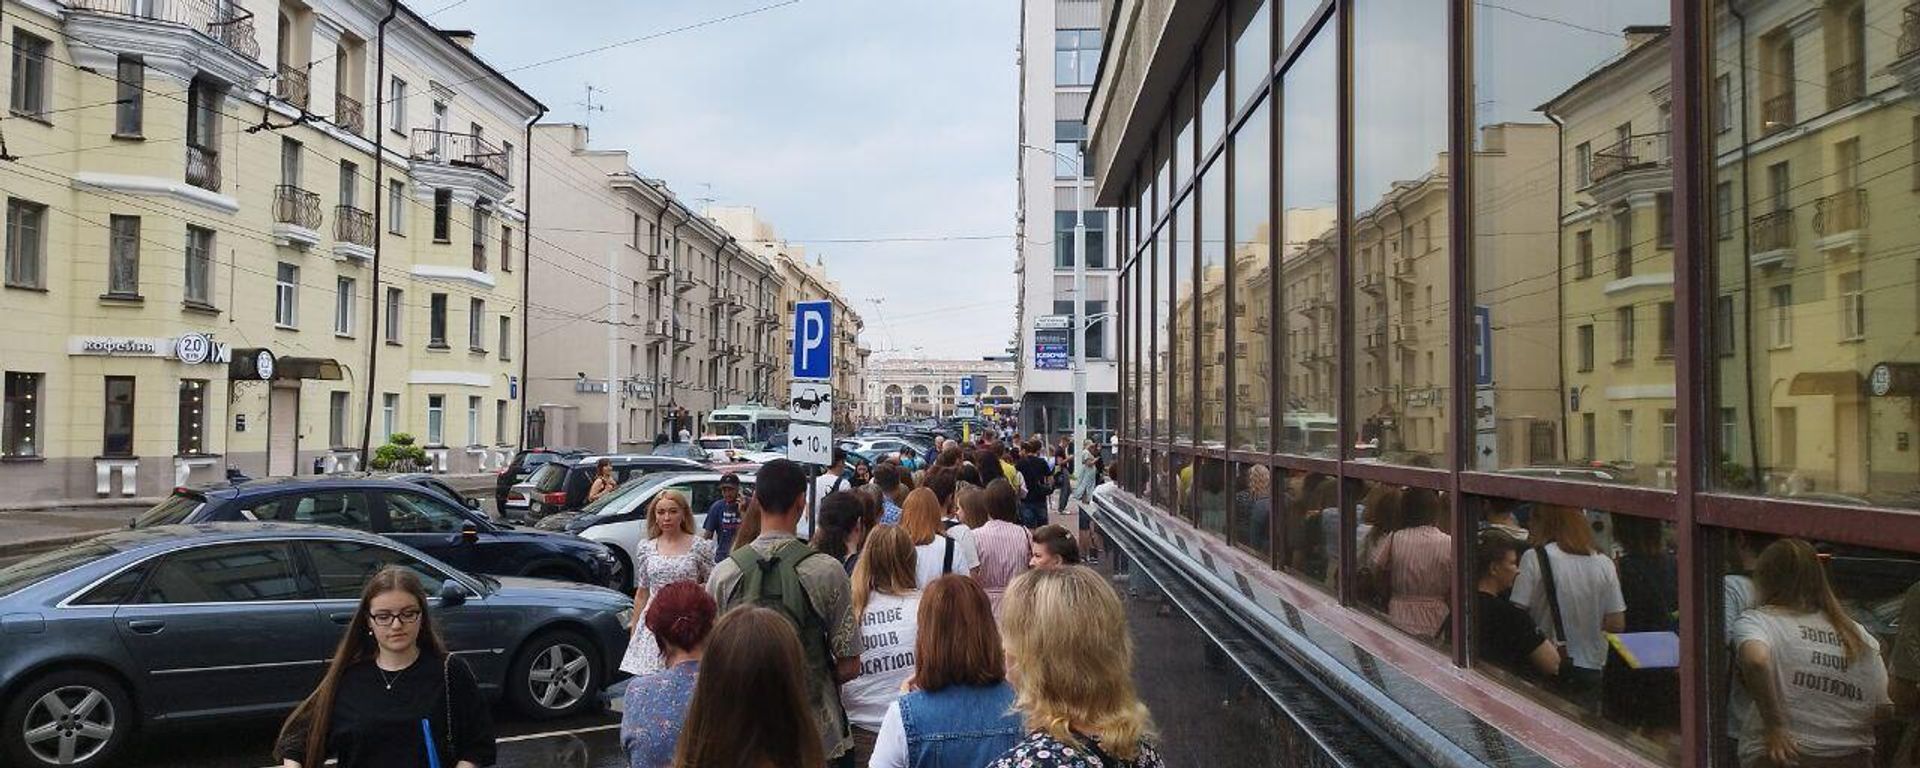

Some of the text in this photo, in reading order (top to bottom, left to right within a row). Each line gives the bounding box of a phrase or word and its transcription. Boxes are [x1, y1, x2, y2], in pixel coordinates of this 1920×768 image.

[84, 339, 156, 354] кофейня
[802, 310, 823, 370] P
[964, 379, 971, 394] P
[807, 435, 820, 453] 10
[861, 631, 900, 650] YOUR
